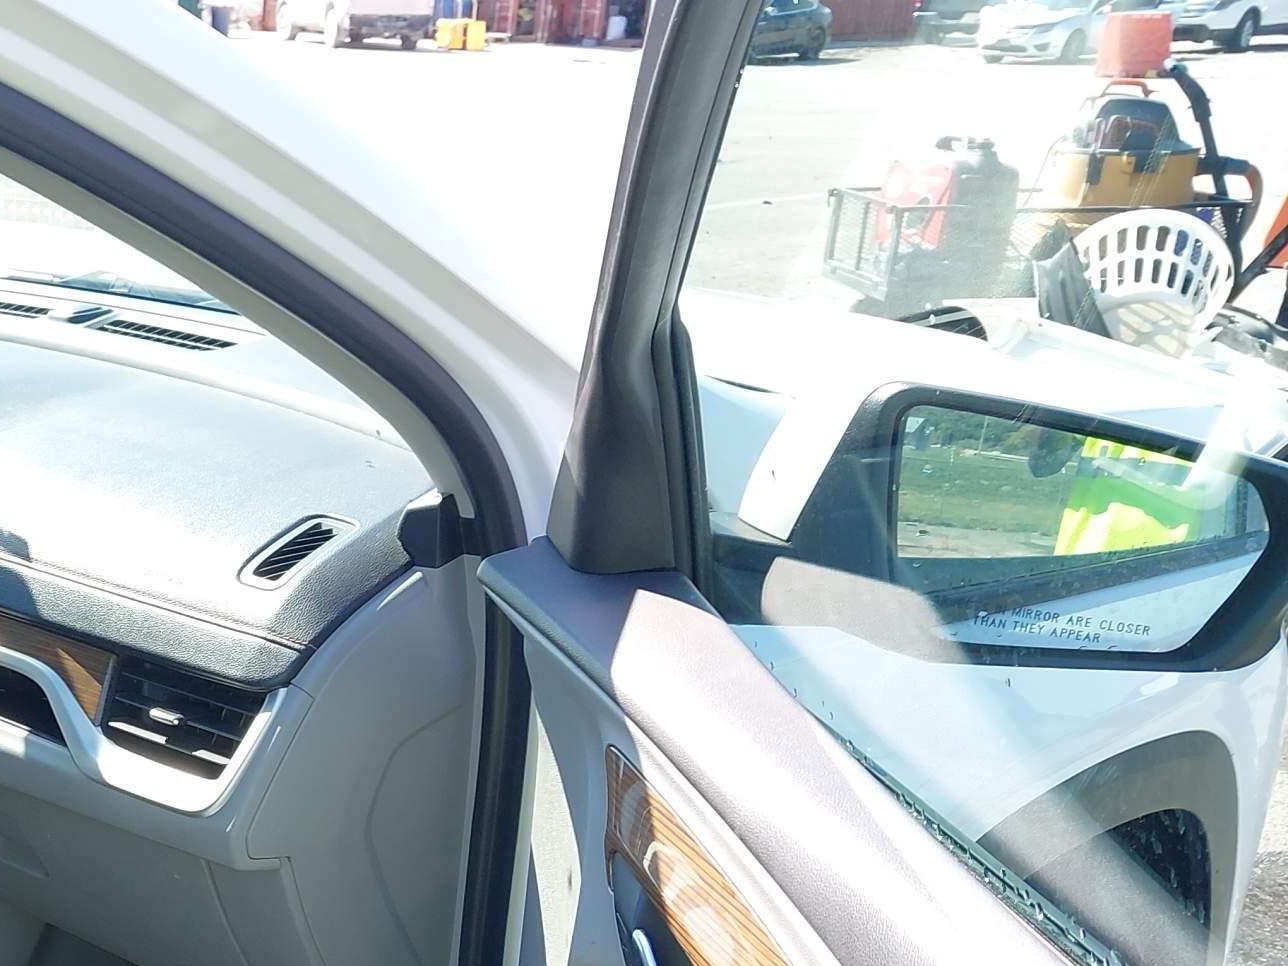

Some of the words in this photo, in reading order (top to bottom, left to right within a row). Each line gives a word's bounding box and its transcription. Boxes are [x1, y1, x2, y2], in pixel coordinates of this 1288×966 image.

[974, 614, 1007, 629] THAN
[1013, 620, 1045, 635] THEY
[1050, 627, 1101, 643] APPEAR
[1012, 607, 1061, 623] MIRROR
[1066, 615, 1092, 628] ARE
[1099, 617, 1152, 636] CLOSER
